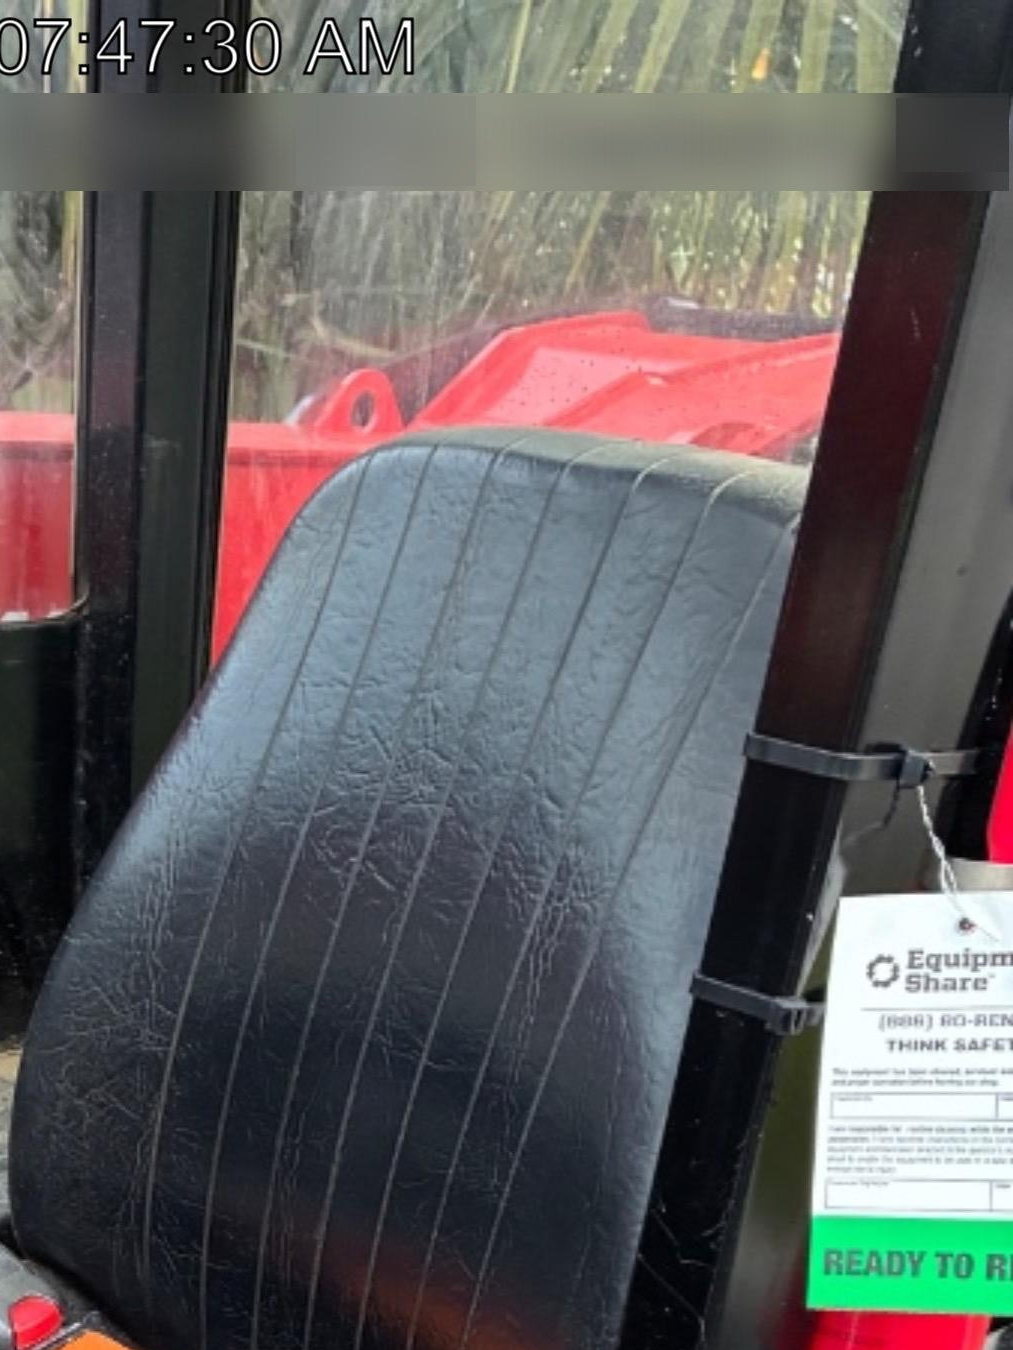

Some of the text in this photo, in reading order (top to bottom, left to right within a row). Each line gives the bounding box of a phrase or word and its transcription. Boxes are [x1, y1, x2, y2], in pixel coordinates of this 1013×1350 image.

[907, 947, 1013, 973] Equipm
[905, 973, 988, 993] Share
[886, 1038, 948, 1054] THINK
[823, 1248, 1013, 1282] READY TO R
